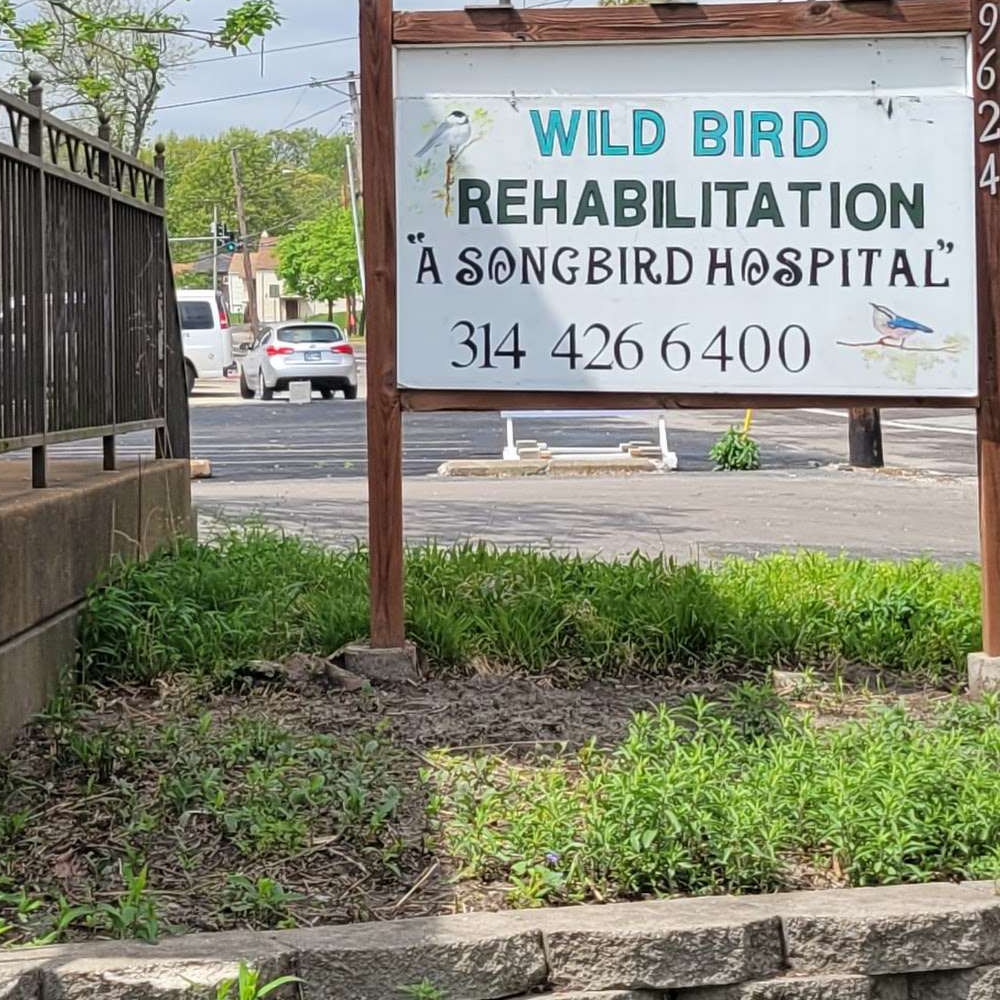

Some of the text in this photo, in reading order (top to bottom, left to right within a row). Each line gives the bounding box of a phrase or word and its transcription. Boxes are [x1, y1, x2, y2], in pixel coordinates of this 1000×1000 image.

[976, 2, 1000, 196] 9624
[529, 109, 829, 158] WILD BIRD
[457, 178, 925, 230] REHABILITATION
[455, 246, 694, 286] SONGBIRD
[450, 320, 812, 373] 314 426 6400
